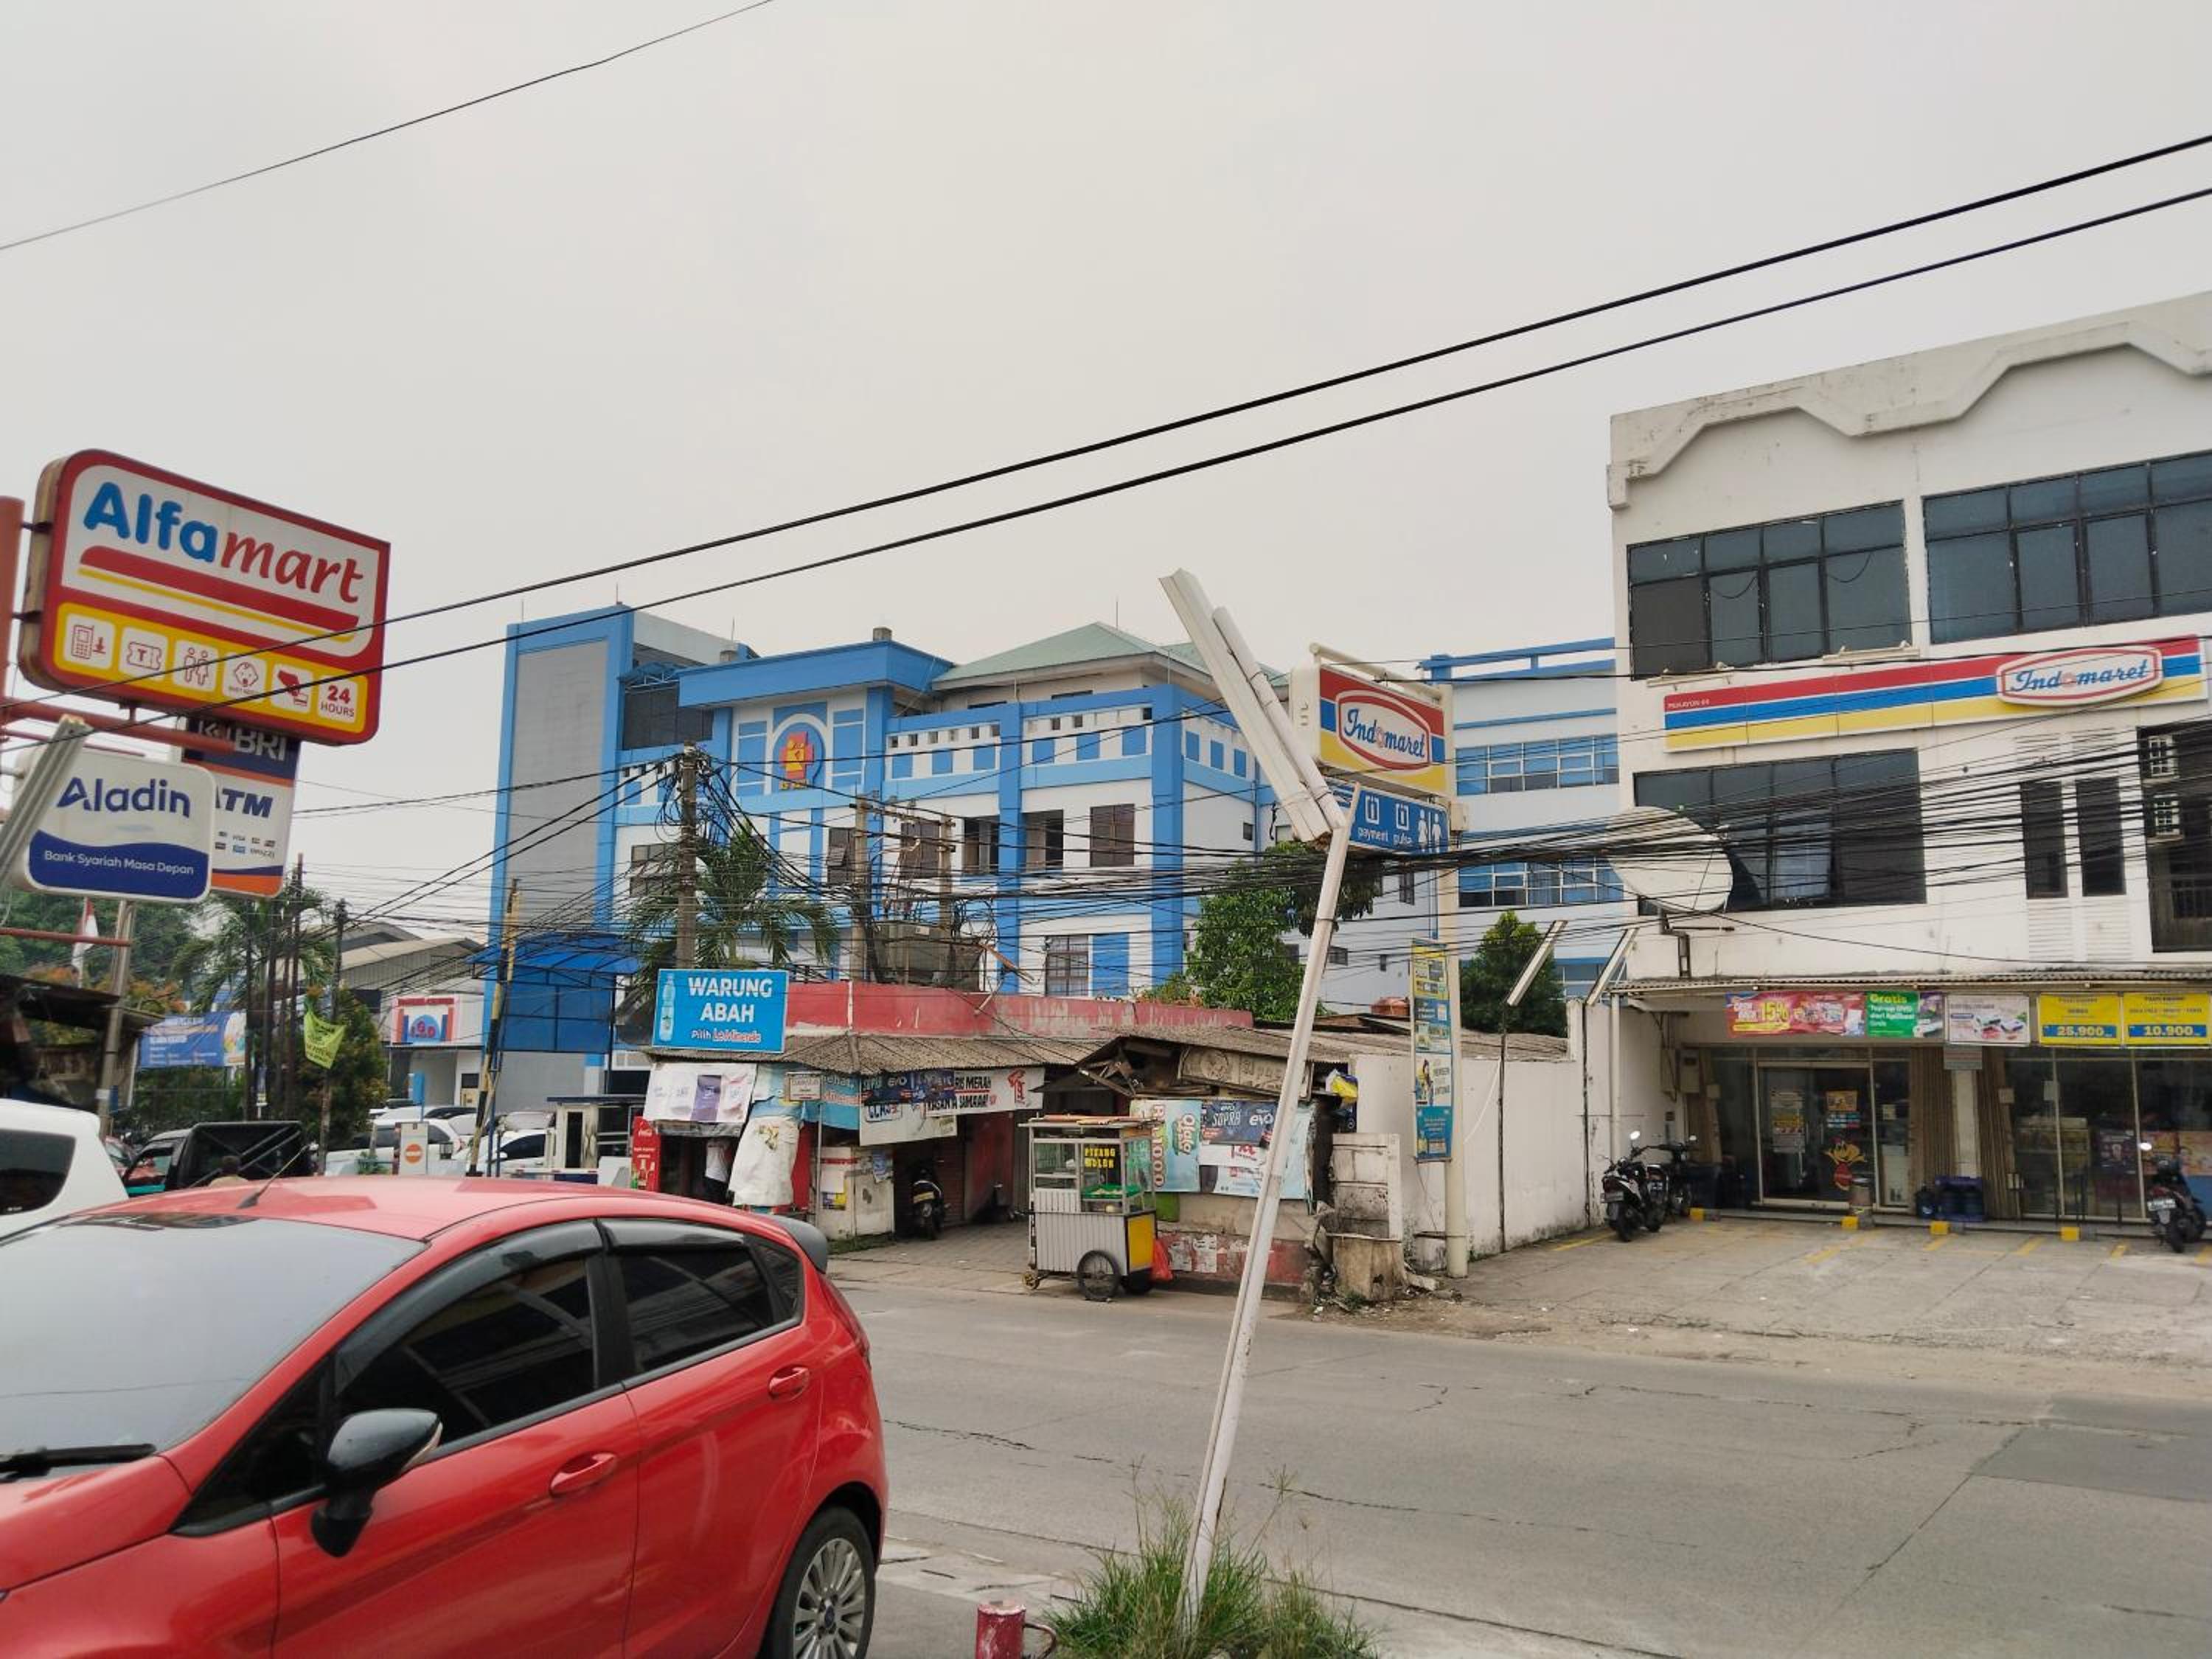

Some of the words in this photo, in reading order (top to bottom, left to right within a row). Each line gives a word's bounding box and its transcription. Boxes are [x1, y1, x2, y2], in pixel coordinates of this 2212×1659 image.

[83, 481, 364, 603] Alfamart
[2011, 659, 2148, 692] Indomaret
[327, 684, 350, 703] 24
[320, 702, 355, 717] HOURS
[236, 727, 287, 761] BRI
[1343, 708, 1426, 758] Indomaret
[56, 776, 191, 818] Aladin
[215, 785, 274, 818] TM
[44, 849, 75, 861] Bank
[77, 853, 122, 869] Syariah
[124, 858, 155, 872] Masa
[156, 861, 194, 875] Depan
[688, 977, 773, 998] WARUNG
[700, 1002, 754, 1023] ABAH
[691, 1029, 712, 1040] Pilih
